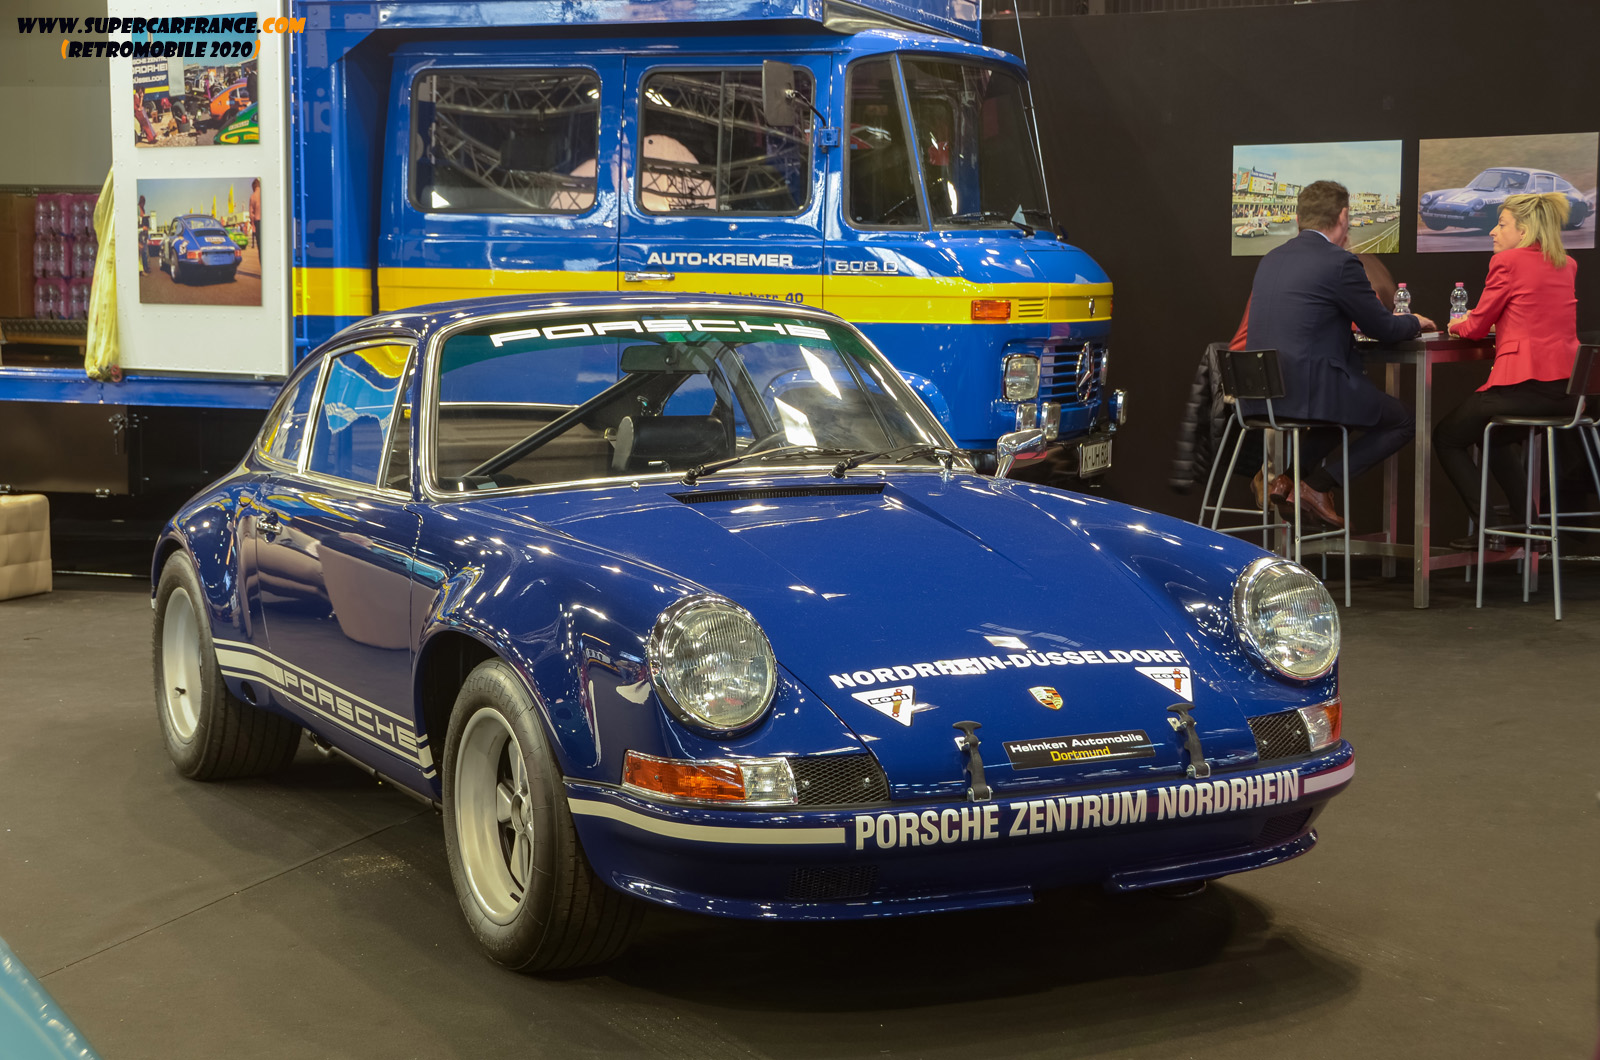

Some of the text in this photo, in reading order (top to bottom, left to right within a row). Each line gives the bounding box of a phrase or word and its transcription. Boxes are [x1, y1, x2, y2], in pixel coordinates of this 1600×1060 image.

[647, 252, 794, 268] AUTO-KREMER
[835, 261, 899, 272] 608 D
[489, 319, 831, 348] PORSCHE
[829, 649, 1183, 689] NORDRHEIN-DÜSSELDORF
[868, 694, 911, 705] KONI
[284, 669, 418, 753] PORSCHE
[1071, 733, 1144, 747] Automobile
[1050, 746, 1111, 761] Dortmund
[855, 769, 1299, 851] PORSCHE ZENTRUM NORDRHEIN
